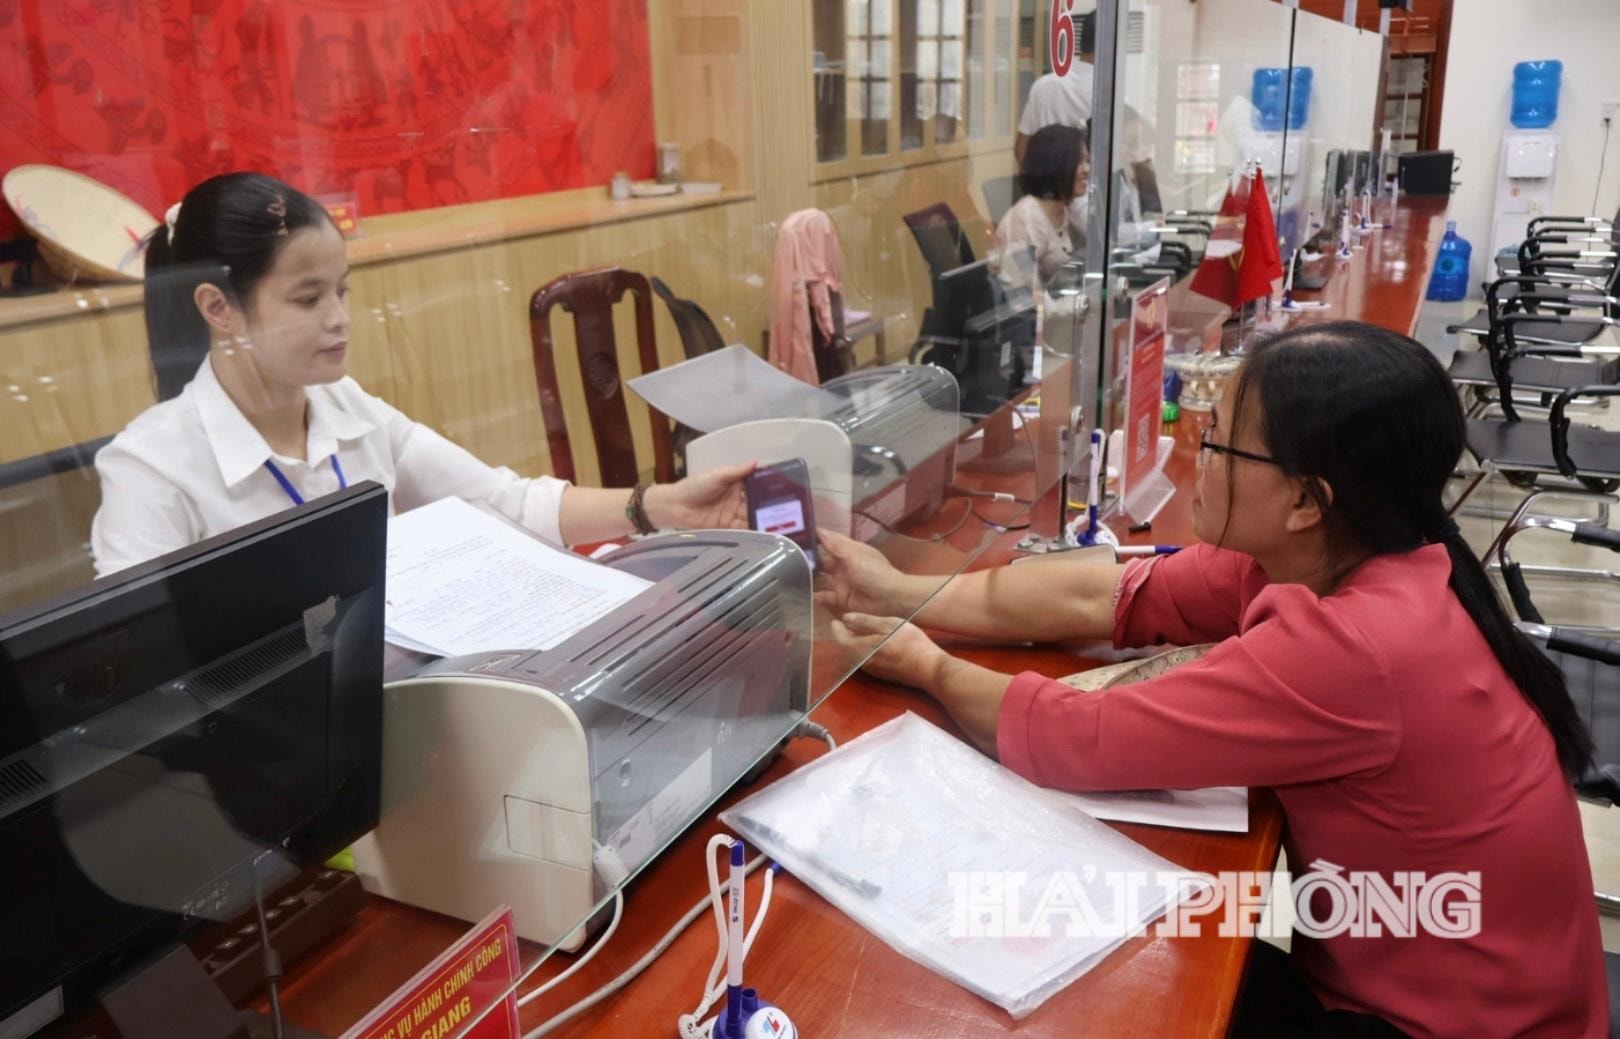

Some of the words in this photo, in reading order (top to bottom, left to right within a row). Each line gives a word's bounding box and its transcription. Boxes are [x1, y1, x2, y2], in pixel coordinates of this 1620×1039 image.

[1050, 0, 1075, 78] 6
[397, 1013, 412, 1039] VỤ
[413, 987, 443, 1026] HÀNH
[443, 962, 475, 999] CHÍNH
[475, 938, 502, 973] CÔNG
